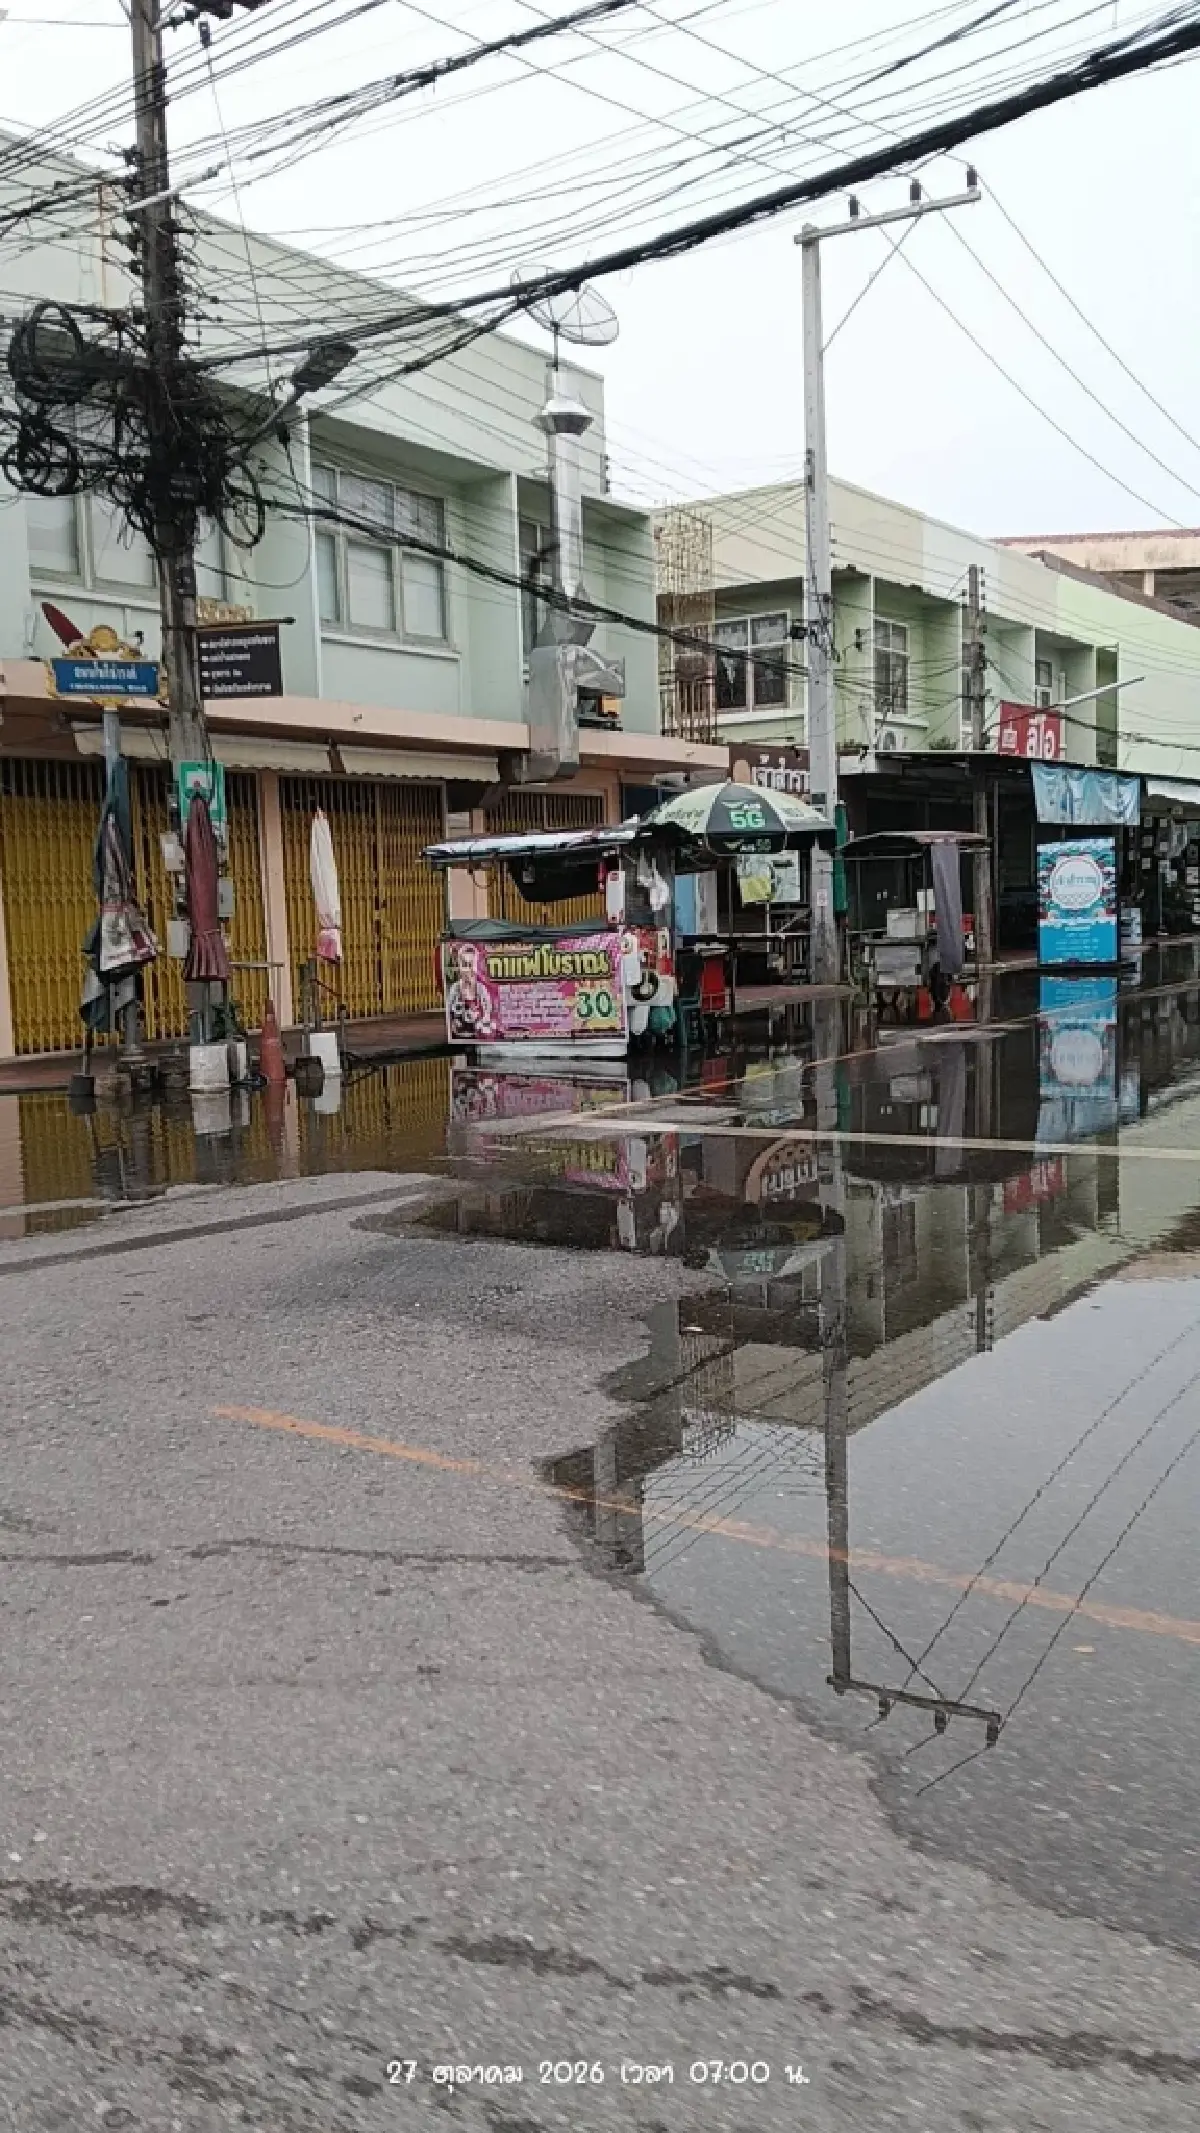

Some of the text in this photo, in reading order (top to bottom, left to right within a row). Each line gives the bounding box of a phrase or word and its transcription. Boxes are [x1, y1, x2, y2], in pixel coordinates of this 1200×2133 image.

[730, 810, 765, 828] 5G
[488, 944, 610, 978] กาแฟโบราณ
[577, 991, 613, 1018] 30
